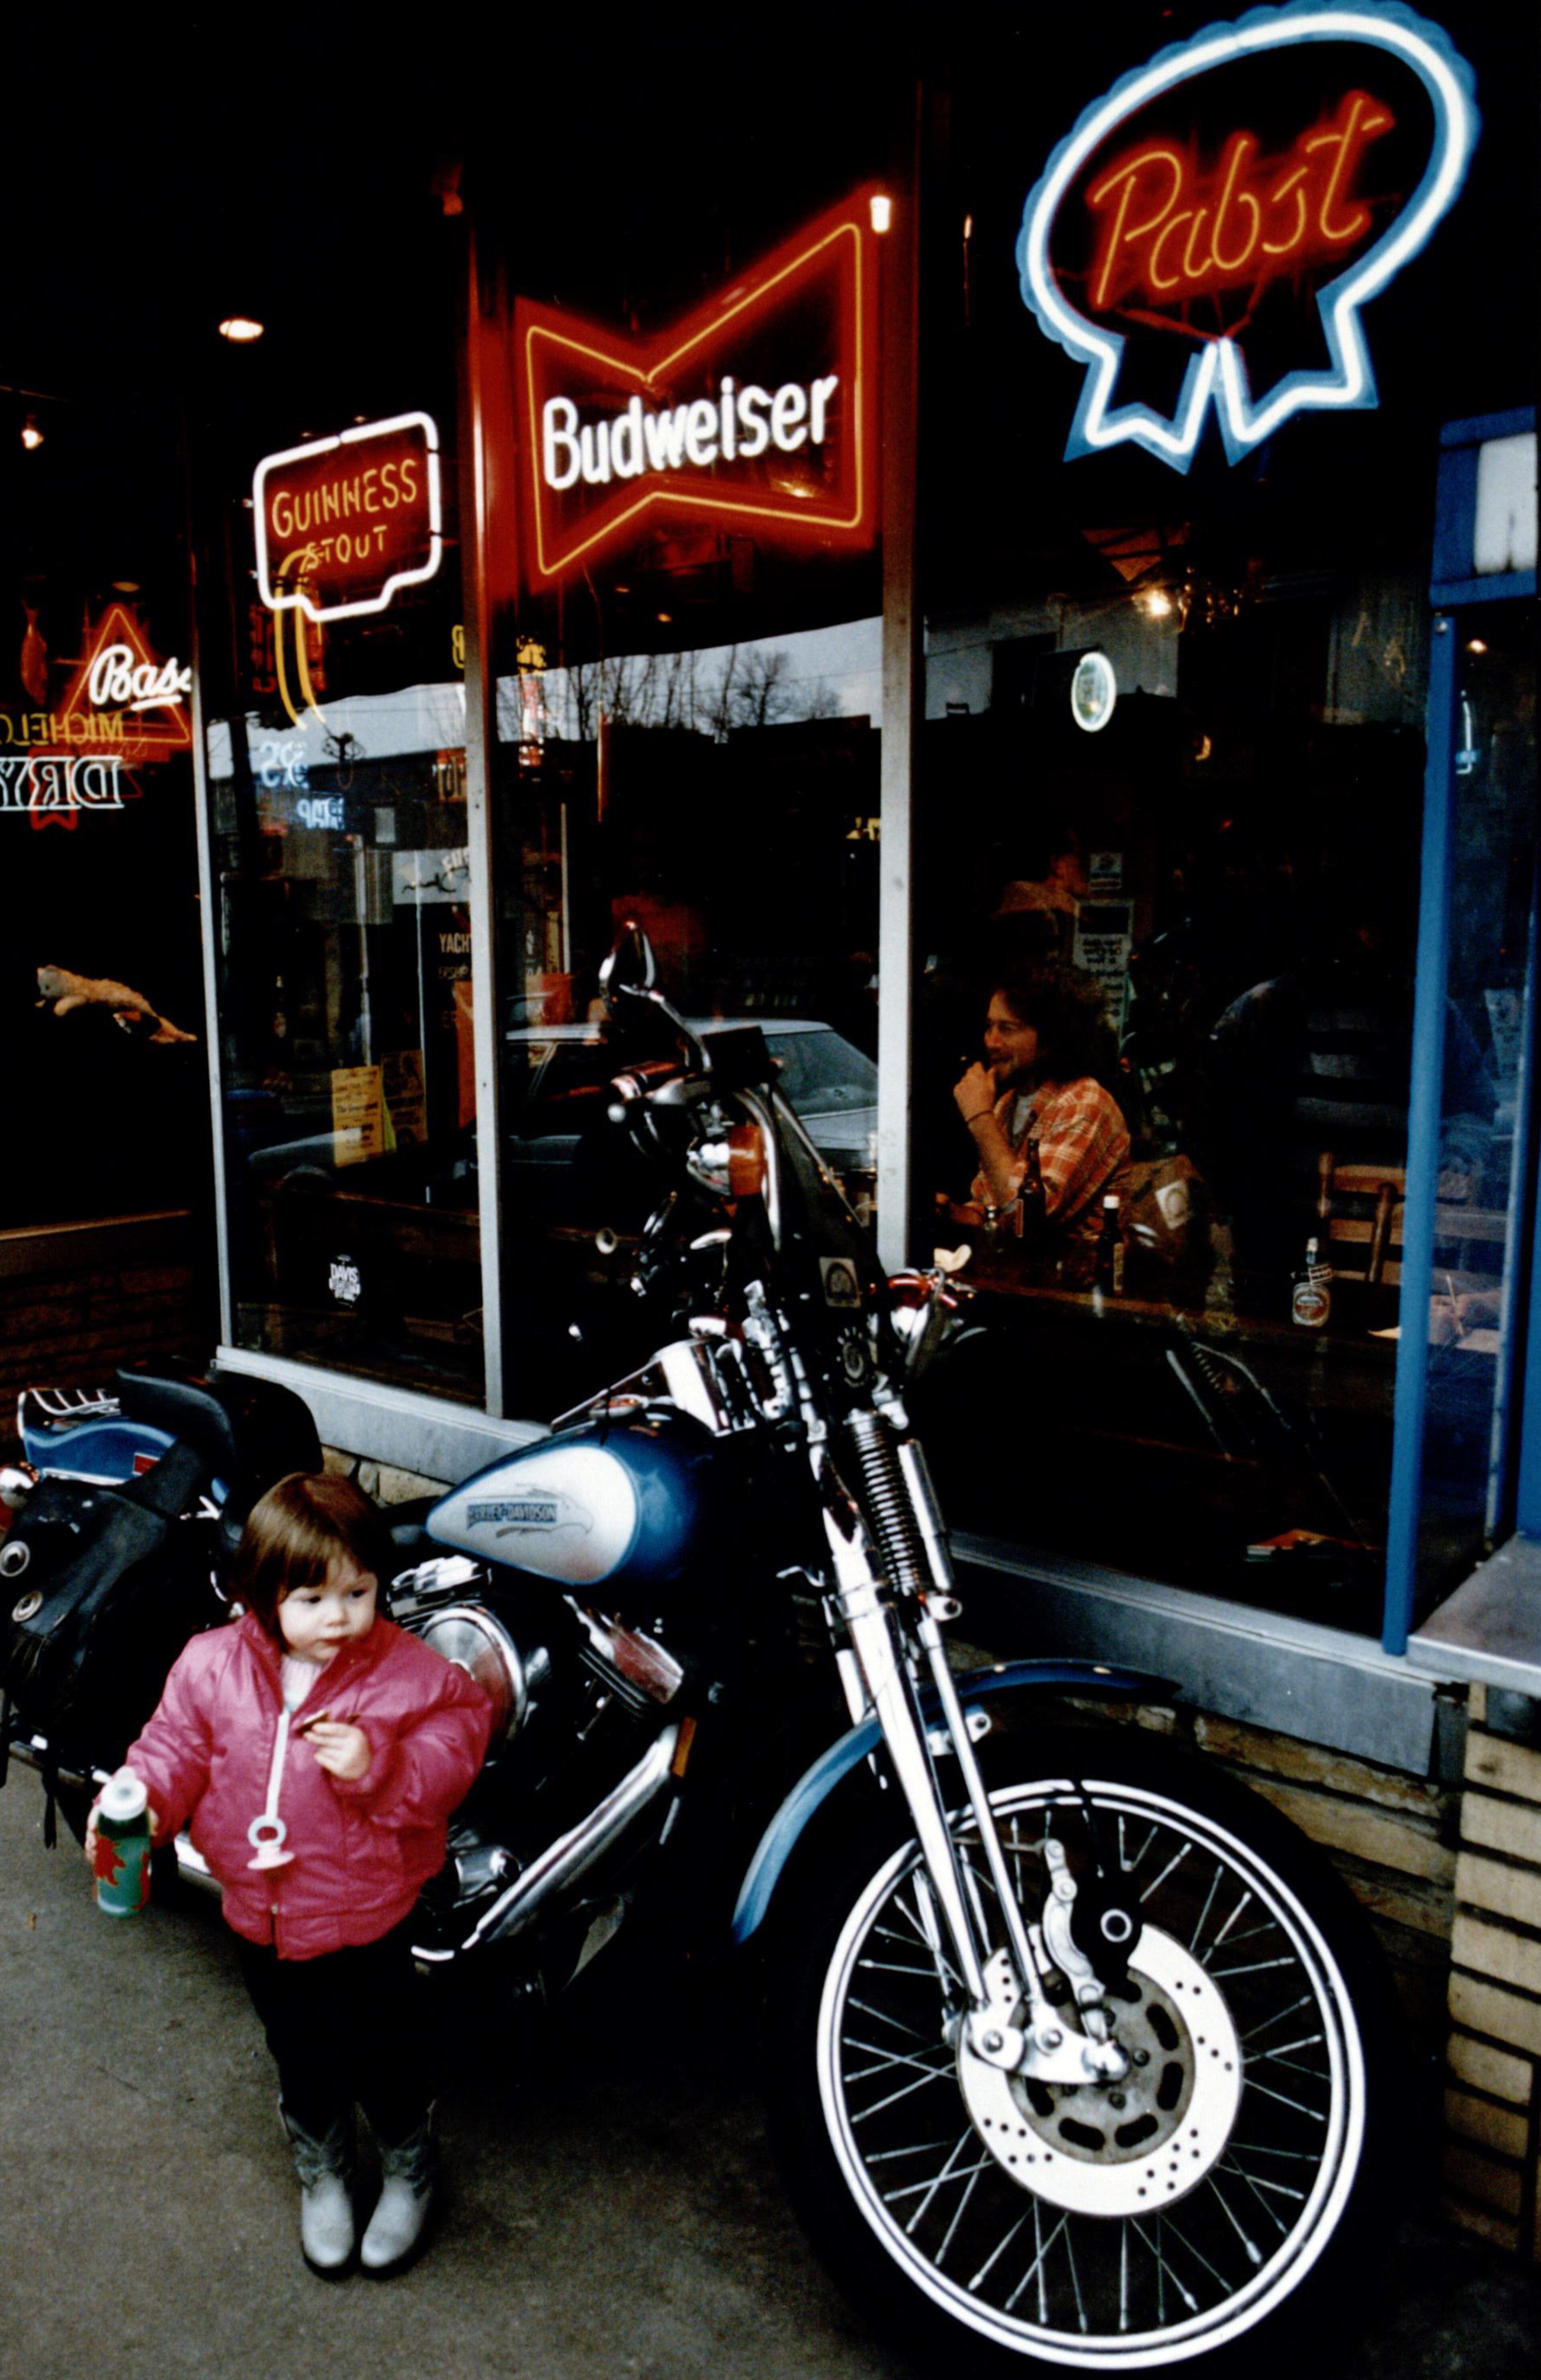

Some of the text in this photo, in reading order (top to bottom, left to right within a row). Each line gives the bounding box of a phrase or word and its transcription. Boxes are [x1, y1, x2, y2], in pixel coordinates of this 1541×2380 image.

[1090, 96, 1389, 307] Pabst
[543, 375, 839, 491] Budweiser
[272, 458, 417, 538] GUINNESS
[305, 524, 388, 569] STOUT
[439, 932, 471, 954] YACH
